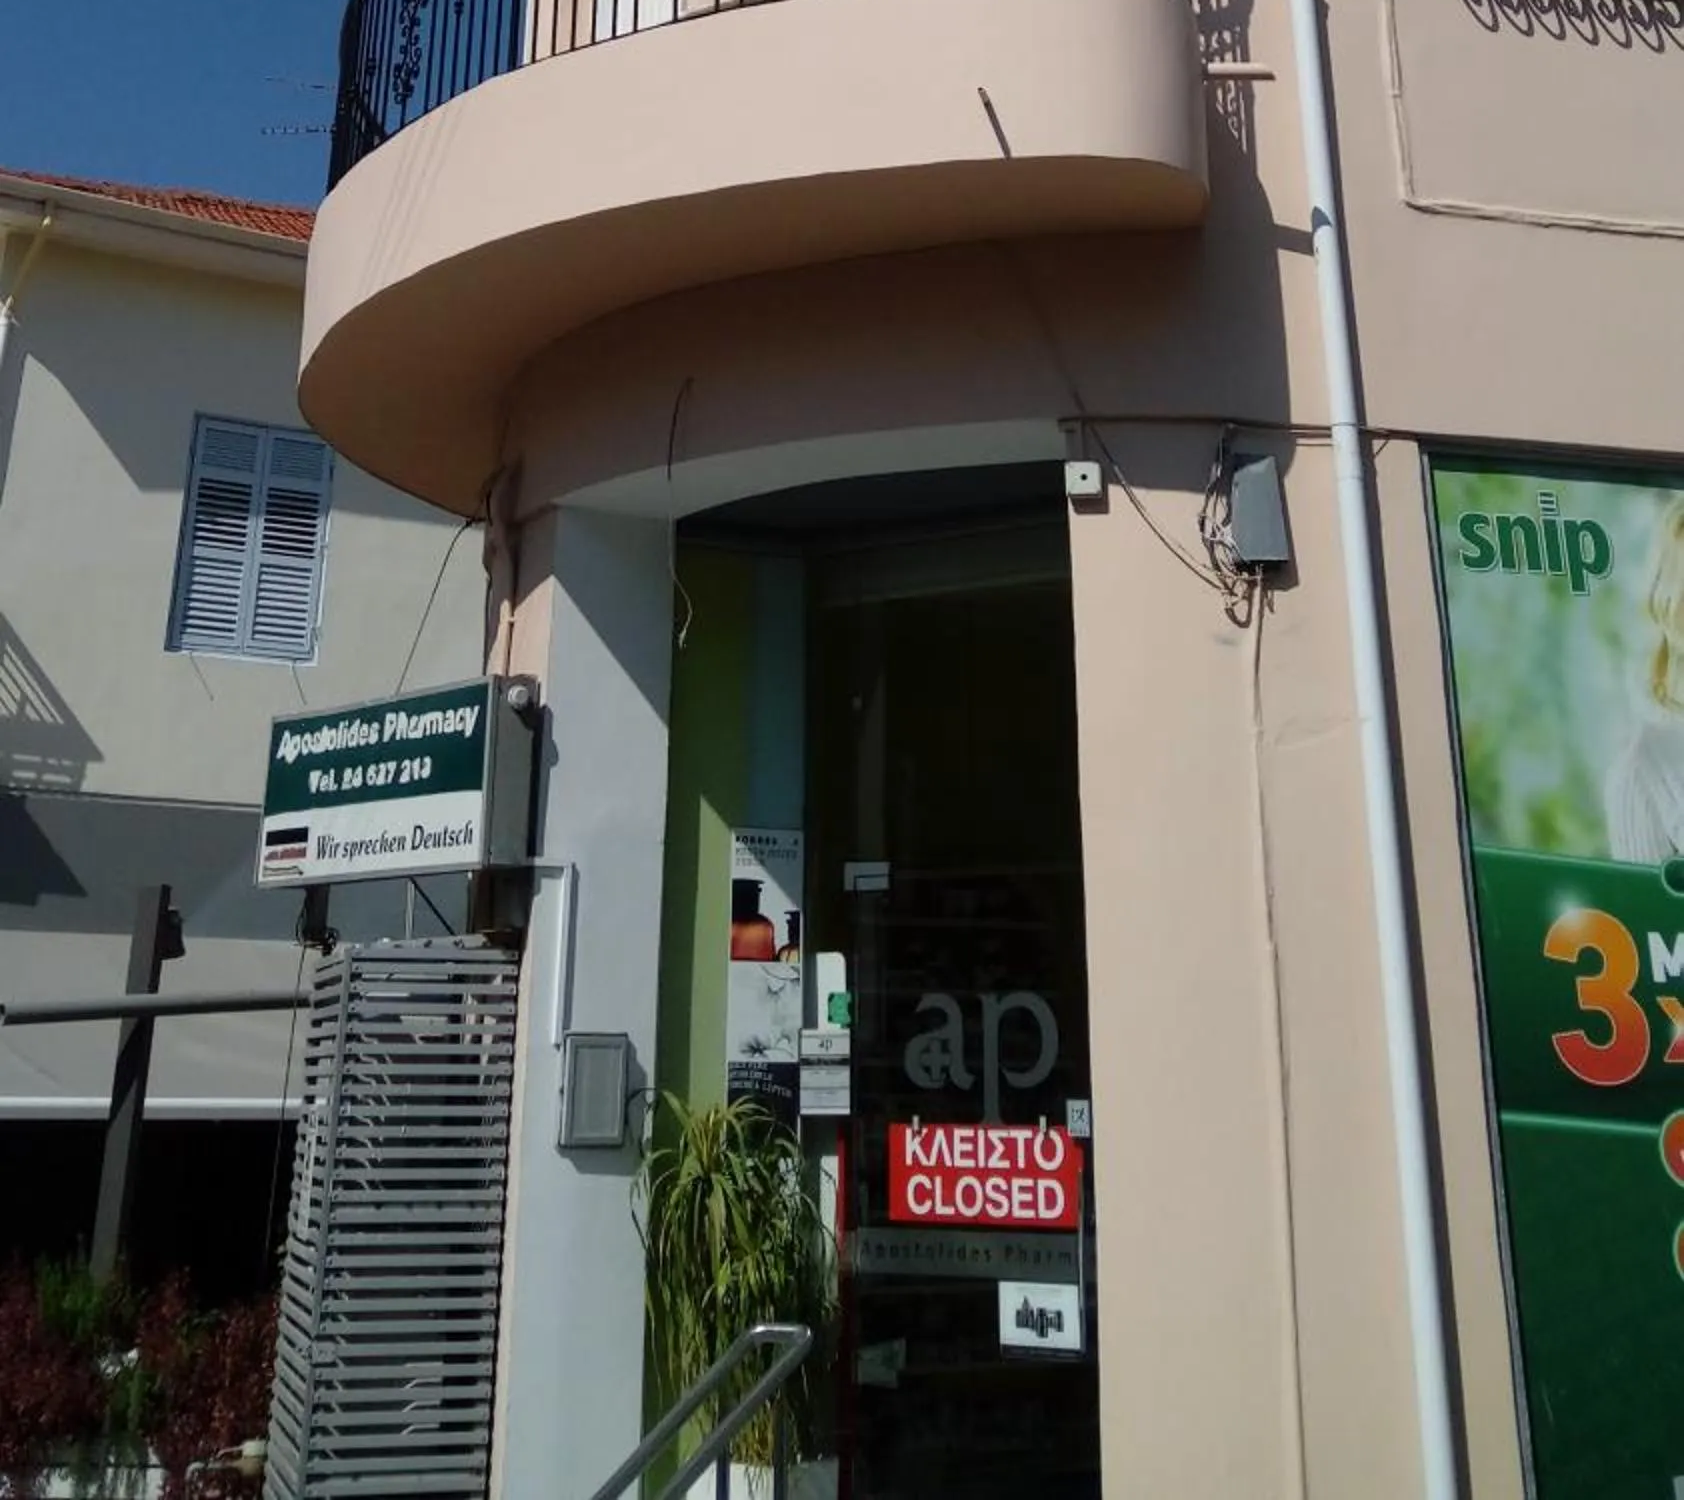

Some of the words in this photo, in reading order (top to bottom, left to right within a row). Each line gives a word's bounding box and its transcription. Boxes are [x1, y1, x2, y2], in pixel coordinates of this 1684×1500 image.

[1458, 490, 1613, 595] snip
[275, 719, 380, 764] Apostolides
[383, 705, 480, 742] Pharmacy
[308, 768, 339, 794] Tel.
[316, 833, 340, 860] Wir
[342, 830, 406, 862] sprechen
[411, 820, 474, 851] Deutsch
[1543, 907, 1651, 1087] 3
[904, 990, 1059, 1125] ap
[905, 1128, 1065, 1171] ΚΛΕΙΣΤΟ
[906, 1175, 1065, 1220] CLOSED
